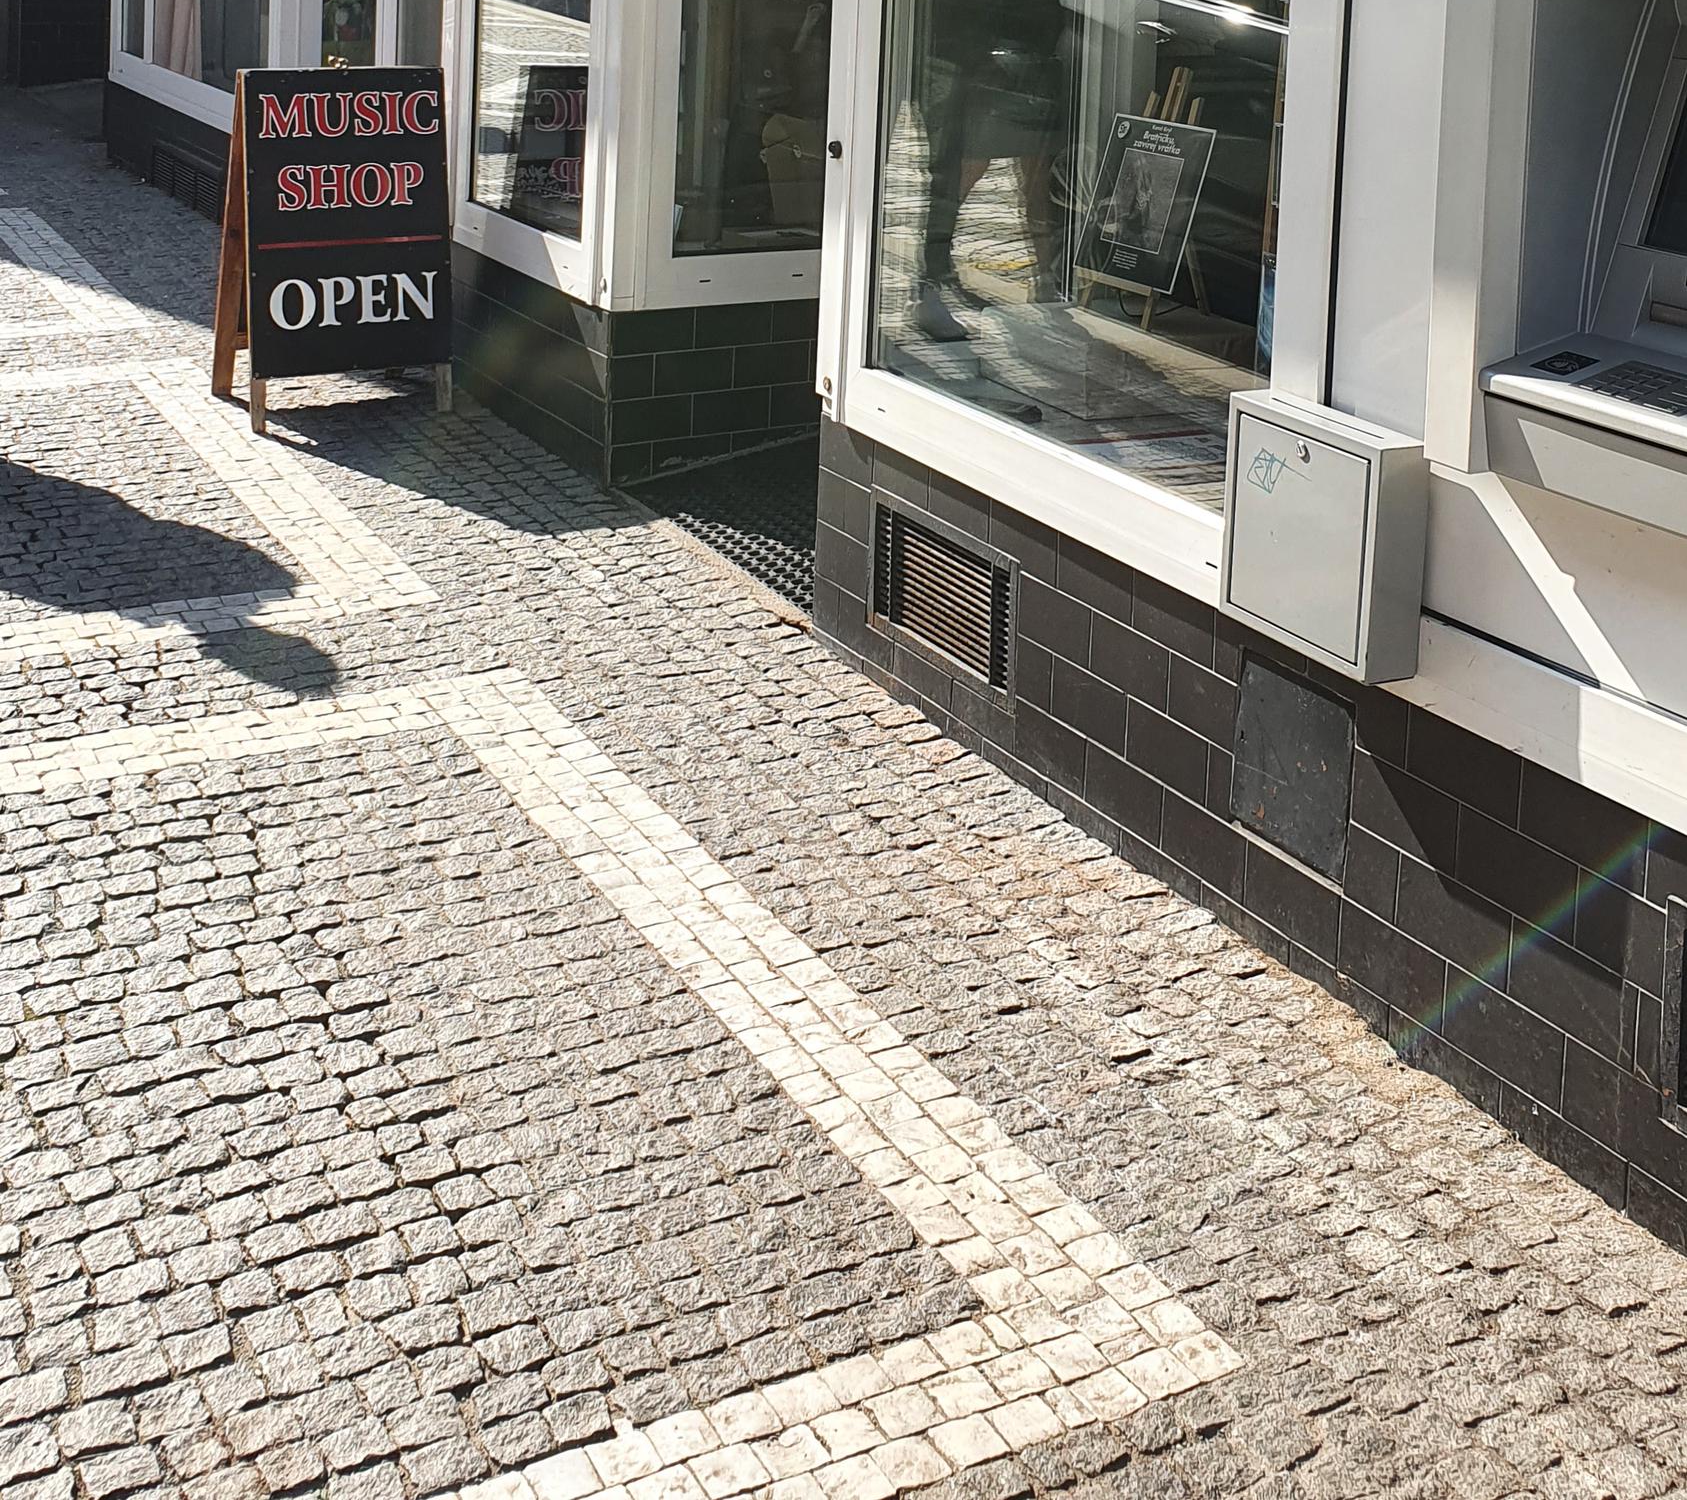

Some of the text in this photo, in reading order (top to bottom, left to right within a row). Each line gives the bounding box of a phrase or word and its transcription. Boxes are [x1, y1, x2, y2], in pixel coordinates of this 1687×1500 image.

[258, 90, 439, 138] MUSIC
[278, 161, 424, 211] SHOP
[269, 271, 438, 331] OPEN
